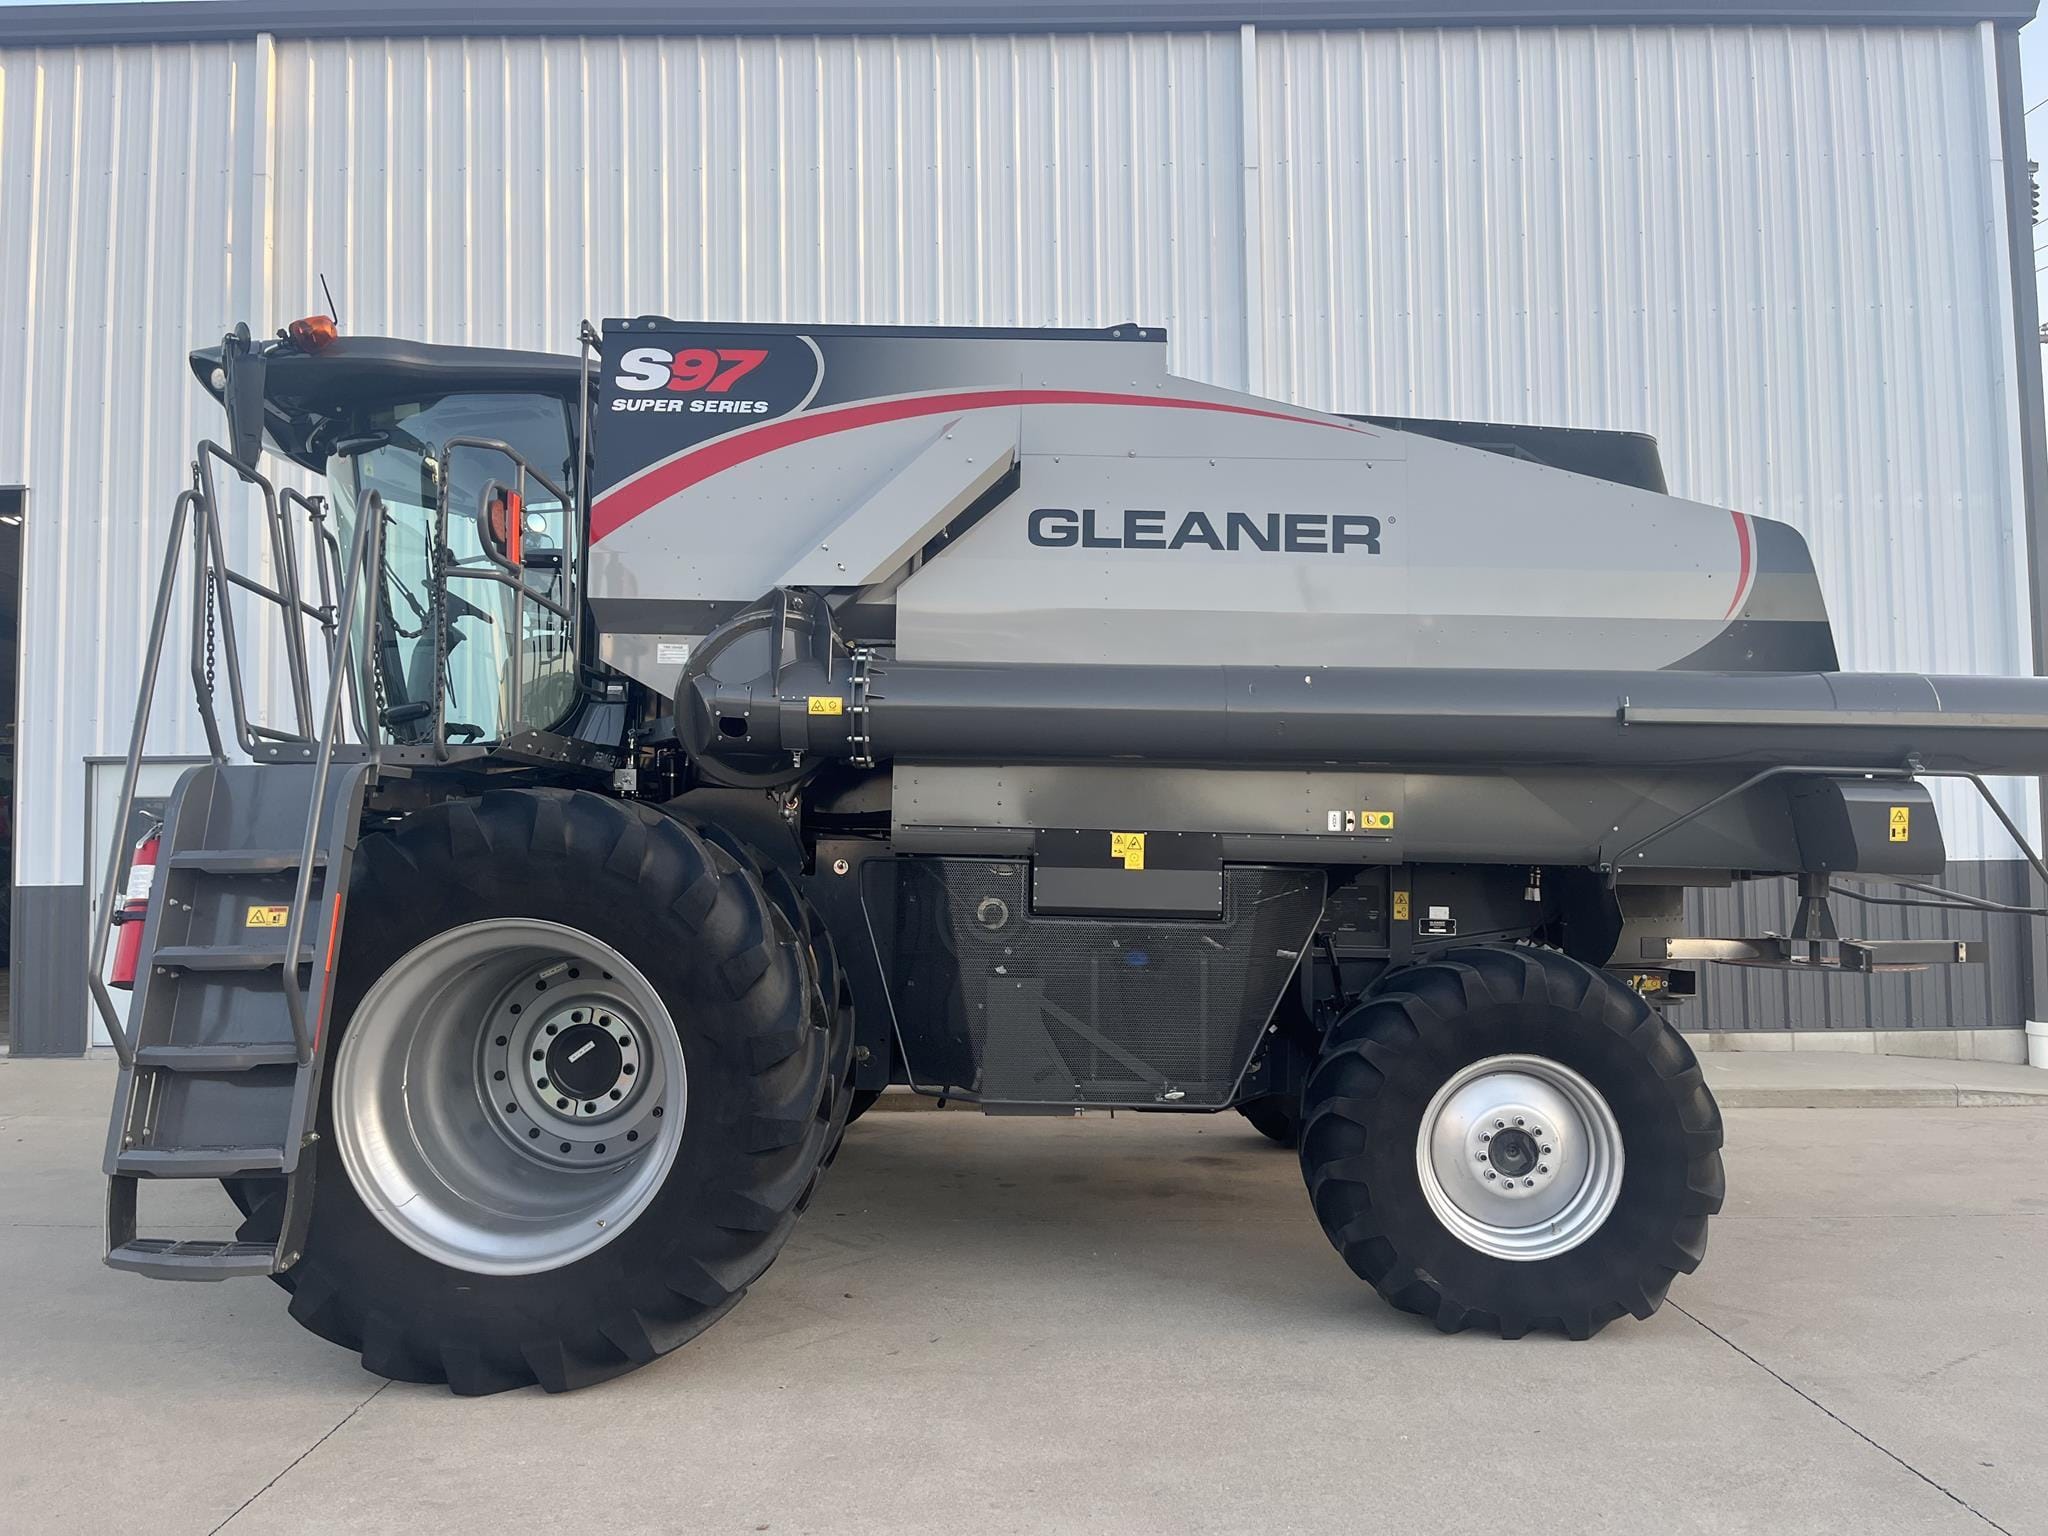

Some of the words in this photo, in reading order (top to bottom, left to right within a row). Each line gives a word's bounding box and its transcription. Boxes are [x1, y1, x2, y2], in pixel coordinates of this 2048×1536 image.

[615, 348, 769, 392] S97
[611, 399, 684, 412] SUPER
[689, 400, 769, 414] SERIES
[1028, 508, 1381, 555] GLEANER
